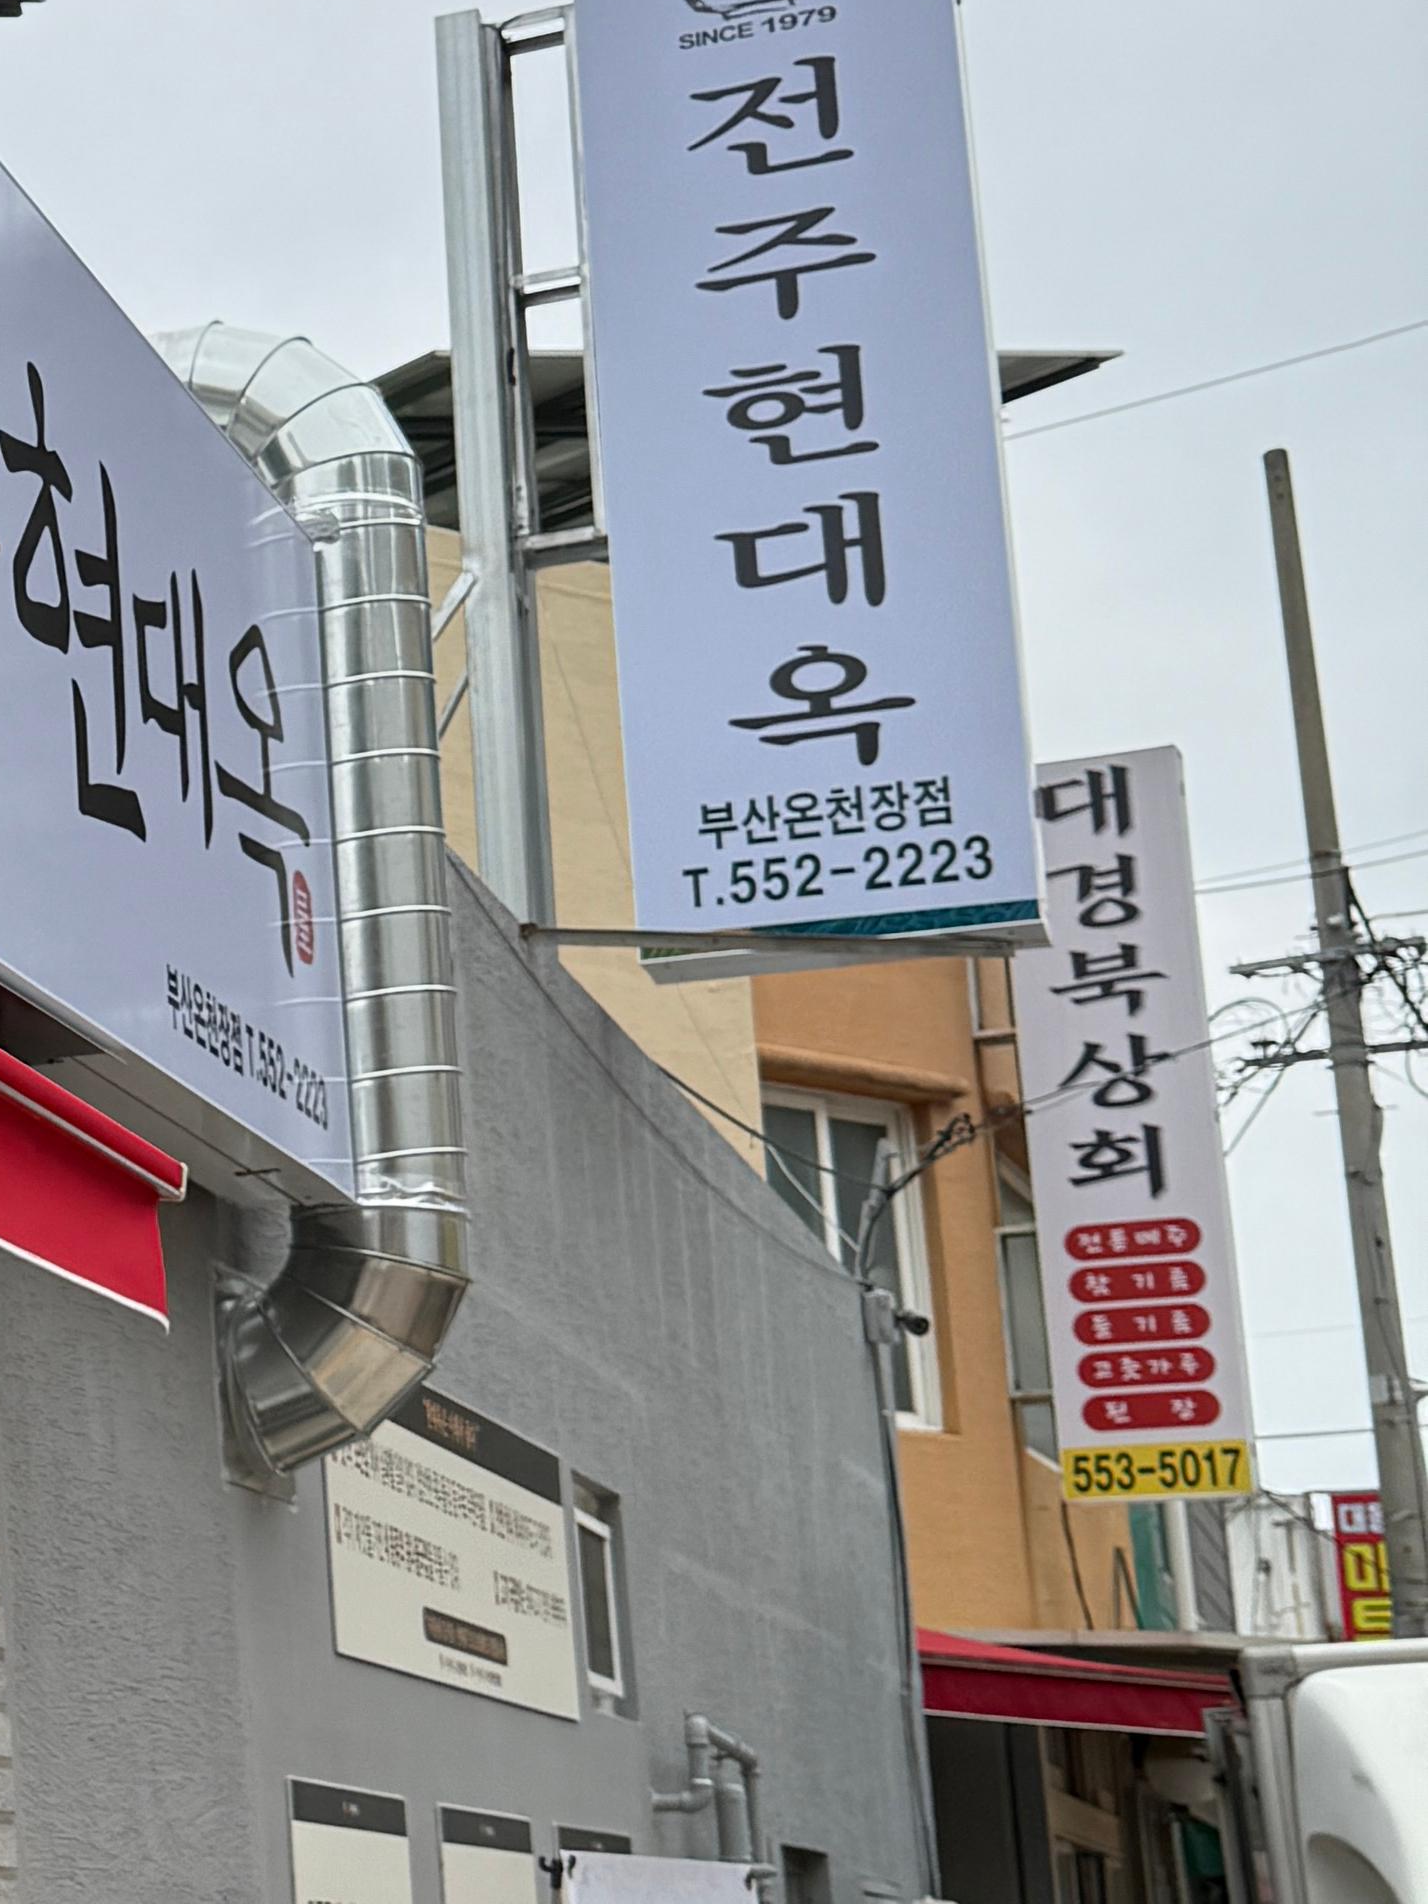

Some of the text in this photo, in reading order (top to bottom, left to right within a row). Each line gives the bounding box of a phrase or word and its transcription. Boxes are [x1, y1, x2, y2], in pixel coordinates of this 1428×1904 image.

[679, 5, 837, 50] SINCE 1979
[686, 54, 916, 766] 전주현대옥
[699, 774, 955, 847] 부산온천장점
[682, 834, 994, 909] T.552-2223
[1038, 763, 1168, 1201] 대경북상회
[166, 963, 245, 1077] 부산온천장점
[1071, 1446, 1241, 1495] 553-5017
